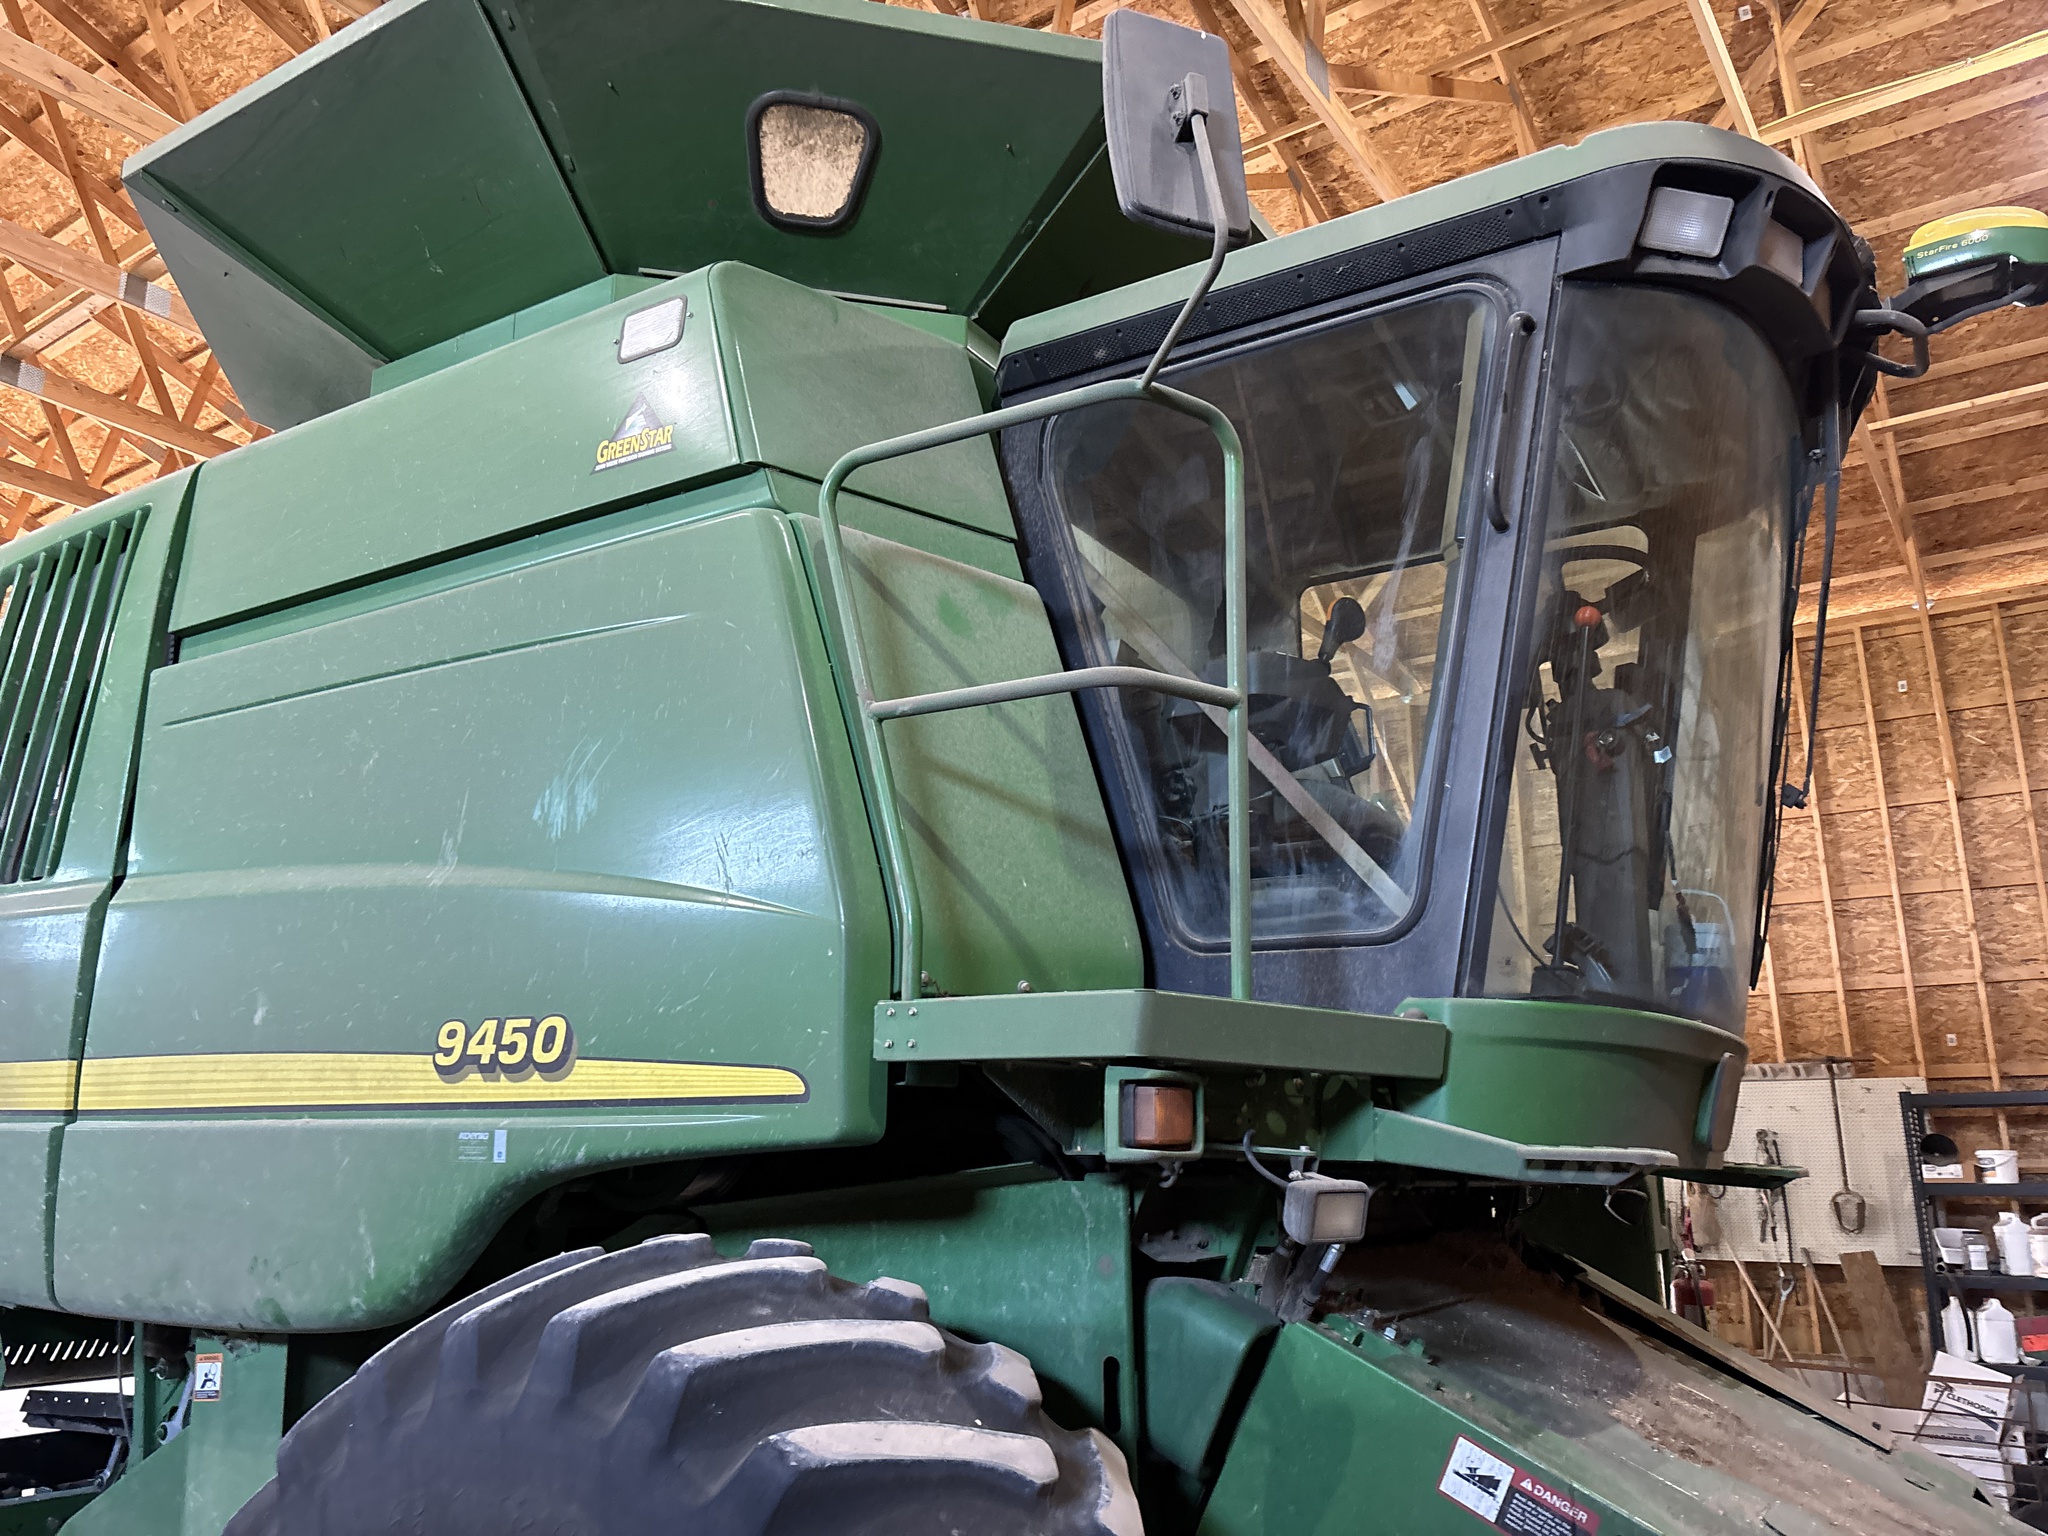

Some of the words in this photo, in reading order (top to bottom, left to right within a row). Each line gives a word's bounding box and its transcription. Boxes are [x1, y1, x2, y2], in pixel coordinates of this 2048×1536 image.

[1916, 242, 1959, 259] StarFire
[1961, 234, 1989, 247] 6000
[433, 1014, 573, 1076] 9450
[1532, 1484, 1588, 1524] DANGER
